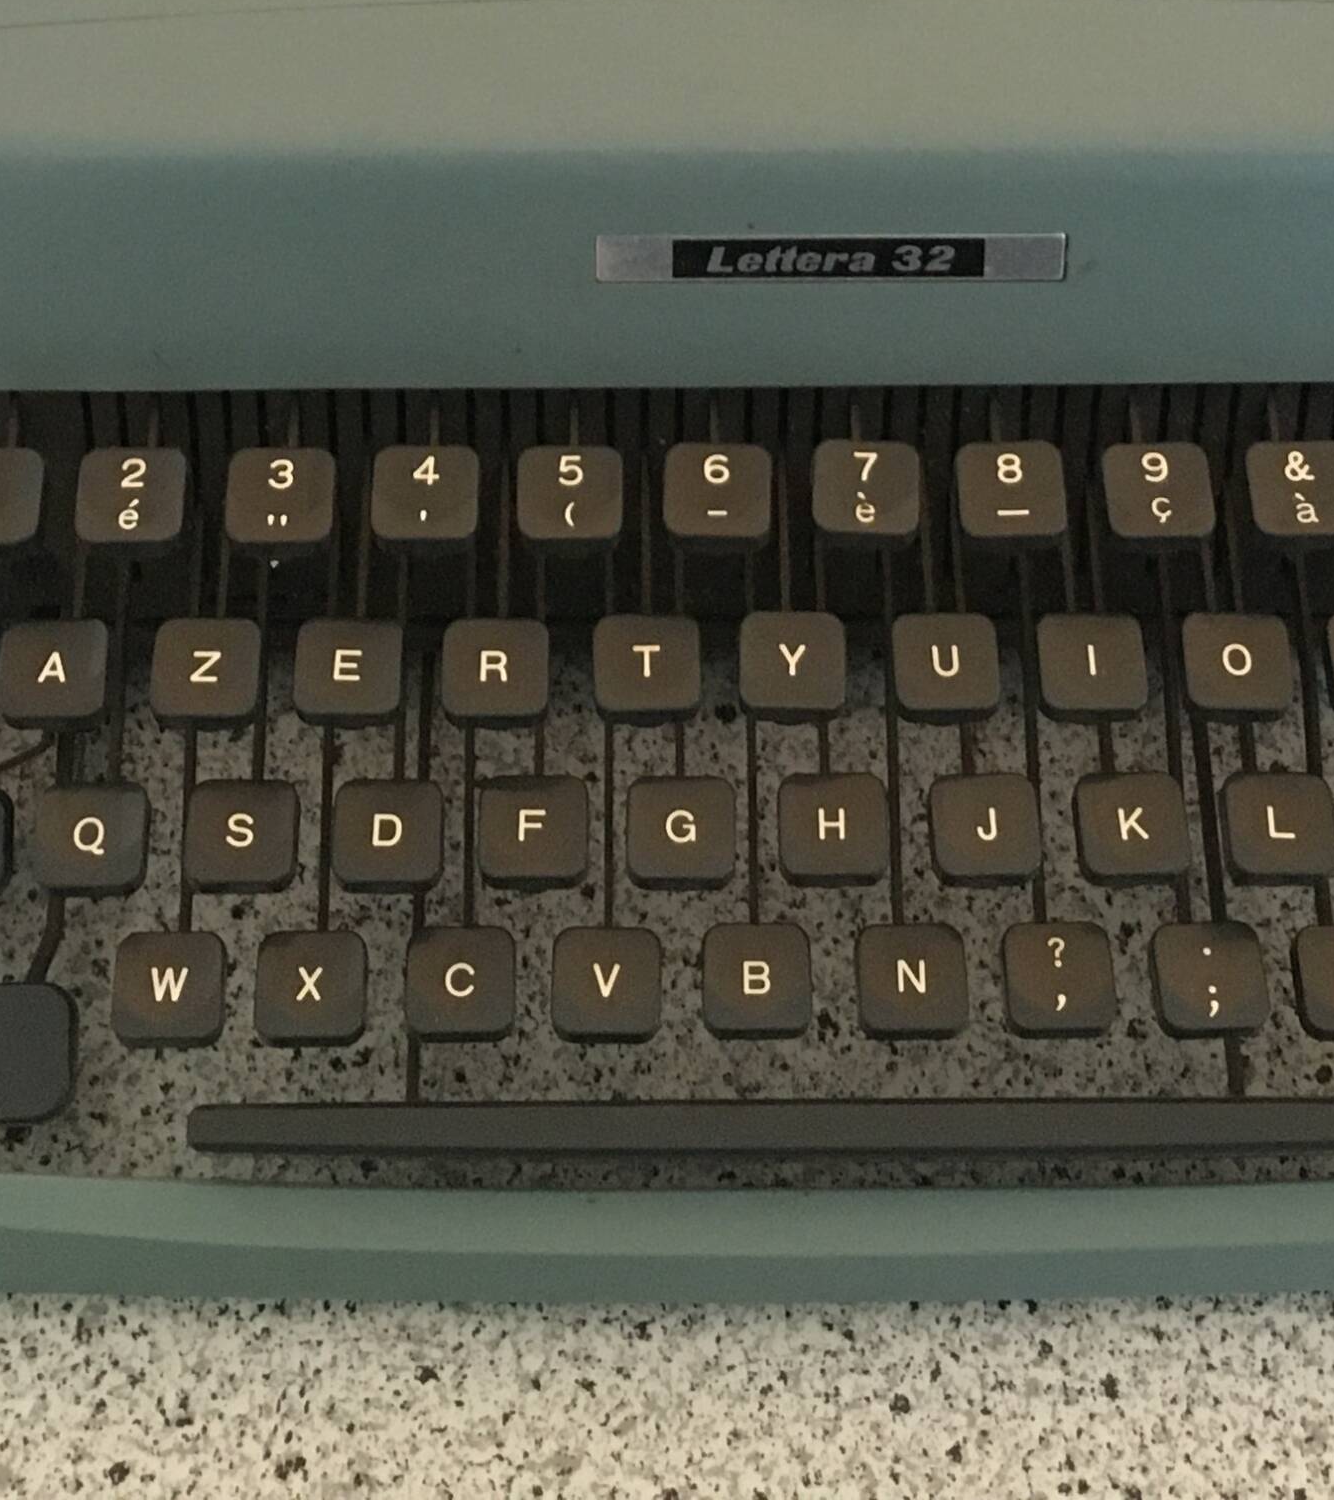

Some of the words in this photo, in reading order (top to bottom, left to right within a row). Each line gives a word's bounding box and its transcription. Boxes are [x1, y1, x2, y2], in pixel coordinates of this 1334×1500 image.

[706, 246, 876, 273] Lettera
[892, 245, 955, 271] 32
[120, 458, 147, 488] 2
[268, 459, 294, 490] 3
[412, 455, 440, 486] 4
[558, 455, 584, 486] 5
[703, 454, 730, 484] 6
[853, 451, 878, 482] 7
[997, 453, 1023, 484] 8
[1141, 452, 1169, 483] 9
[1284, 450, 1315, 482] &
[118, 498, 140, 530] é
[855, 491, 876, 524] è
[1151, 497, 1172, 524] ç
[1294, 492, 1320, 524] à
[37, 651, 66, 683] A
[189, 650, 222, 683] Z
[333, 649, 363, 681] E
[479, 650, 508, 682] R
[632, 644, 661, 678] T
[779, 643, 806, 676] Y
[931, 644, 960, 677] U
[1087, 644, 1097, 676] I
[1222, 643, 1252, 676] O
[72, 816, 105, 856] Q
[226, 813, 254, 848] S
[372, 813, 403, 847] D
[518, 809, 546, 842] F
[665, 809, 697, 844] G
[818, 808, 846, 840] H
[976, 807, 997, 841] J
[1117, 807, 1150, 841] K
[1266, 805, 1296, 839] L
[1047, 937, 1065, 968] ?
[151, 967, 189, 1002] W
[296, 966, 323, 1001] X
[445, 962, 475, 997] C
[593, 963, 621, 998] V
[743, 960, 771, 995] B
[897, 959, 926, 994] N
